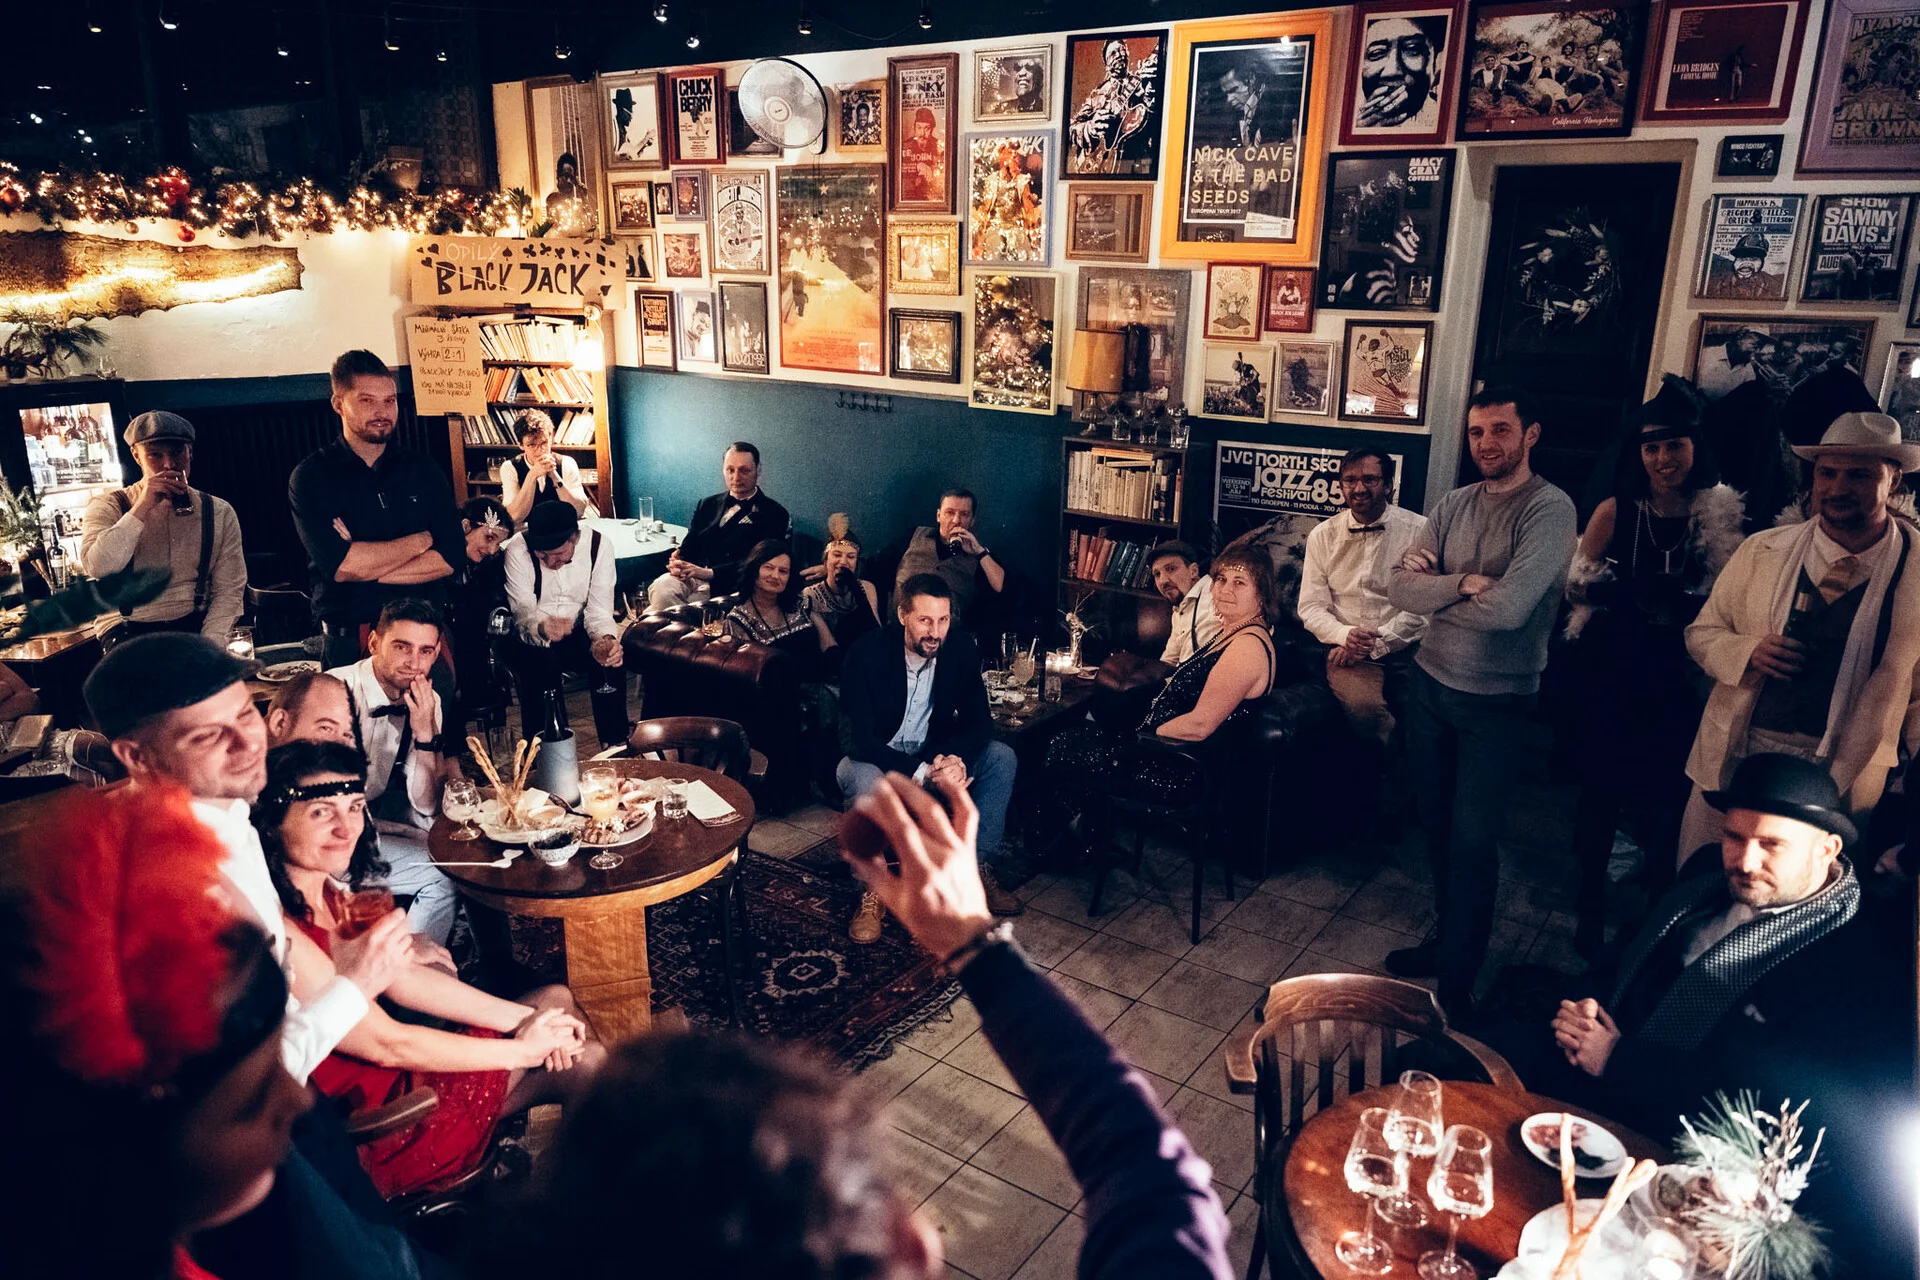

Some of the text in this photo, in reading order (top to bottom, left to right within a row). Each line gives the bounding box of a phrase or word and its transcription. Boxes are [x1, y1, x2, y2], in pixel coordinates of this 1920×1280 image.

[1691, 62, 1720, 72] BRIDGES
[679, 78, 713, 96] CHUCK
[1552, 117, 1581, 127] California
[1194, 146, 1294, 161] NICK CAVE
[1409, 156, 1444, 166] MACY
[1193, 168, 1291, 183] & THE BAD
[1409, 166, 1440, 175] GRAY
[1191, 190, 1250, 204] SEEDS
[1841, 197, 1889, 208] SHOW
[1824, 207, 1898, 227] SAMMY
[1821, 225, 1878, 243] DAVIS
[436, 262, 591, 296] BLACK JACK
[1221, 449, 1253, 465] JVC
[1261, 487, 1310, 502] Festival
[1311, 478, 1346, 505] 85
